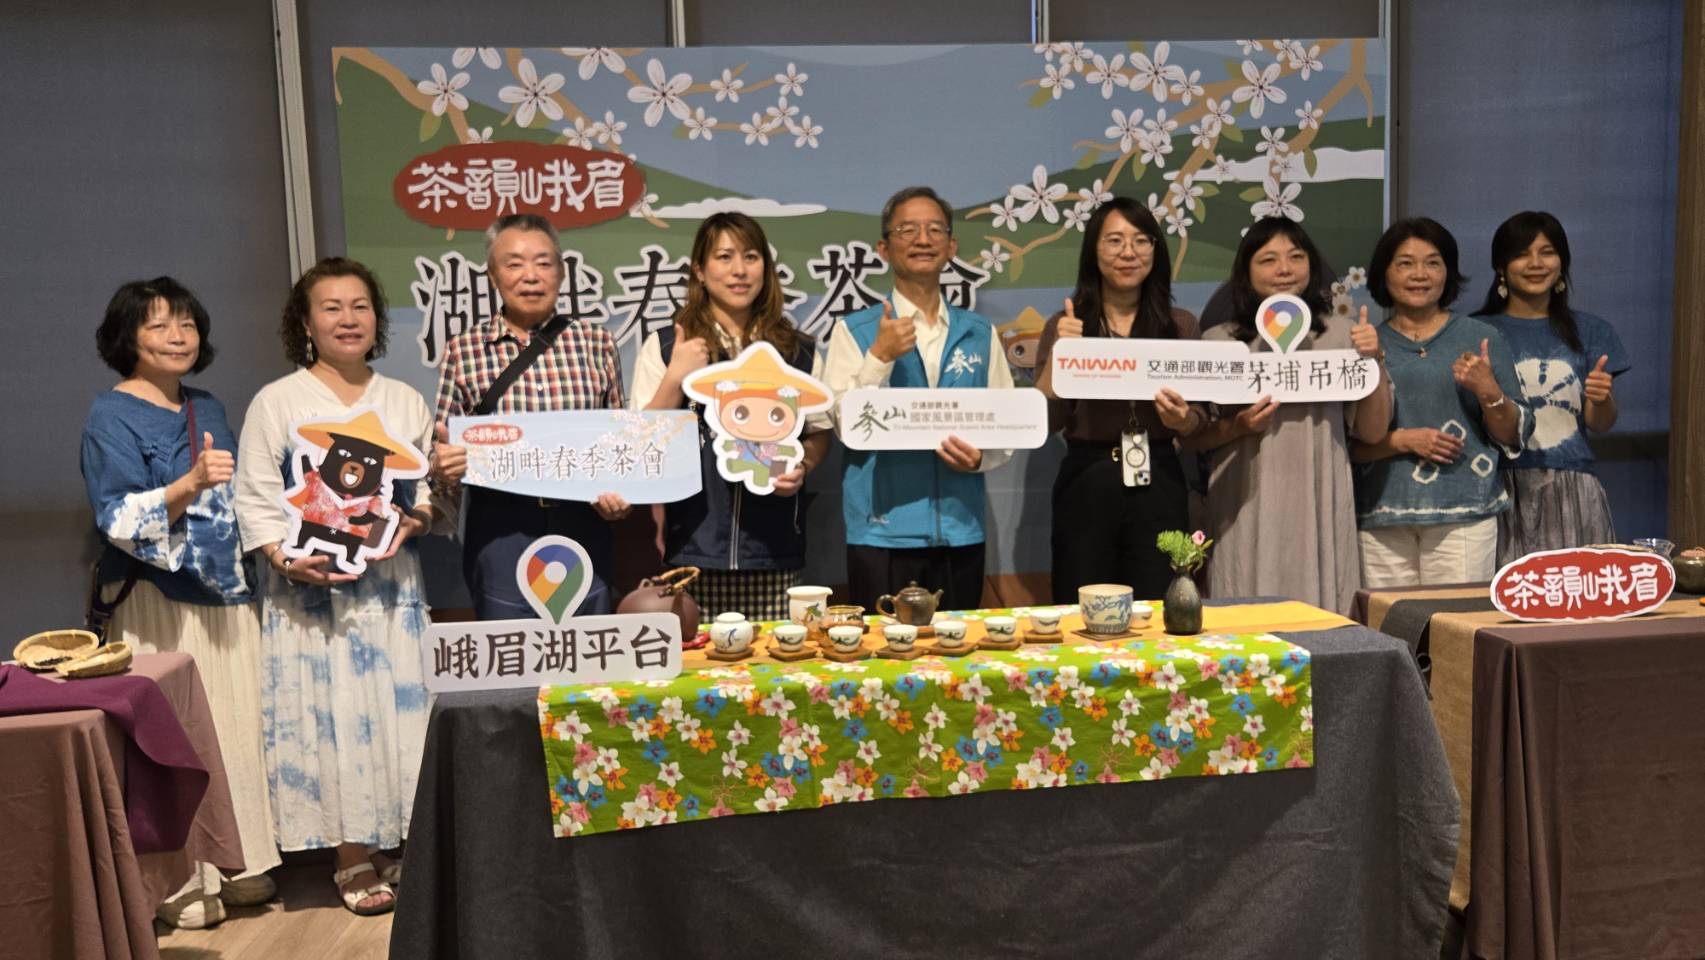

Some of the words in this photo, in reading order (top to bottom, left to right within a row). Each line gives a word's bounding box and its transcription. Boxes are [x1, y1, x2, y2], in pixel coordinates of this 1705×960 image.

[407, 158, 625, 216] 茶韻峨眉
[1057, 357, 1137, 371] TAIWAN
[1147, 359, 1245, 374] 交通部觀光署
[1248, 358, 1368, 394] 茅埔吊橋
[490, 442, 664, 480] 湖畔春季茶會
[1504, 563, 1658, 610] 茶韻峨眉
[434, 625, 672, 680] 峨眉湖平台
